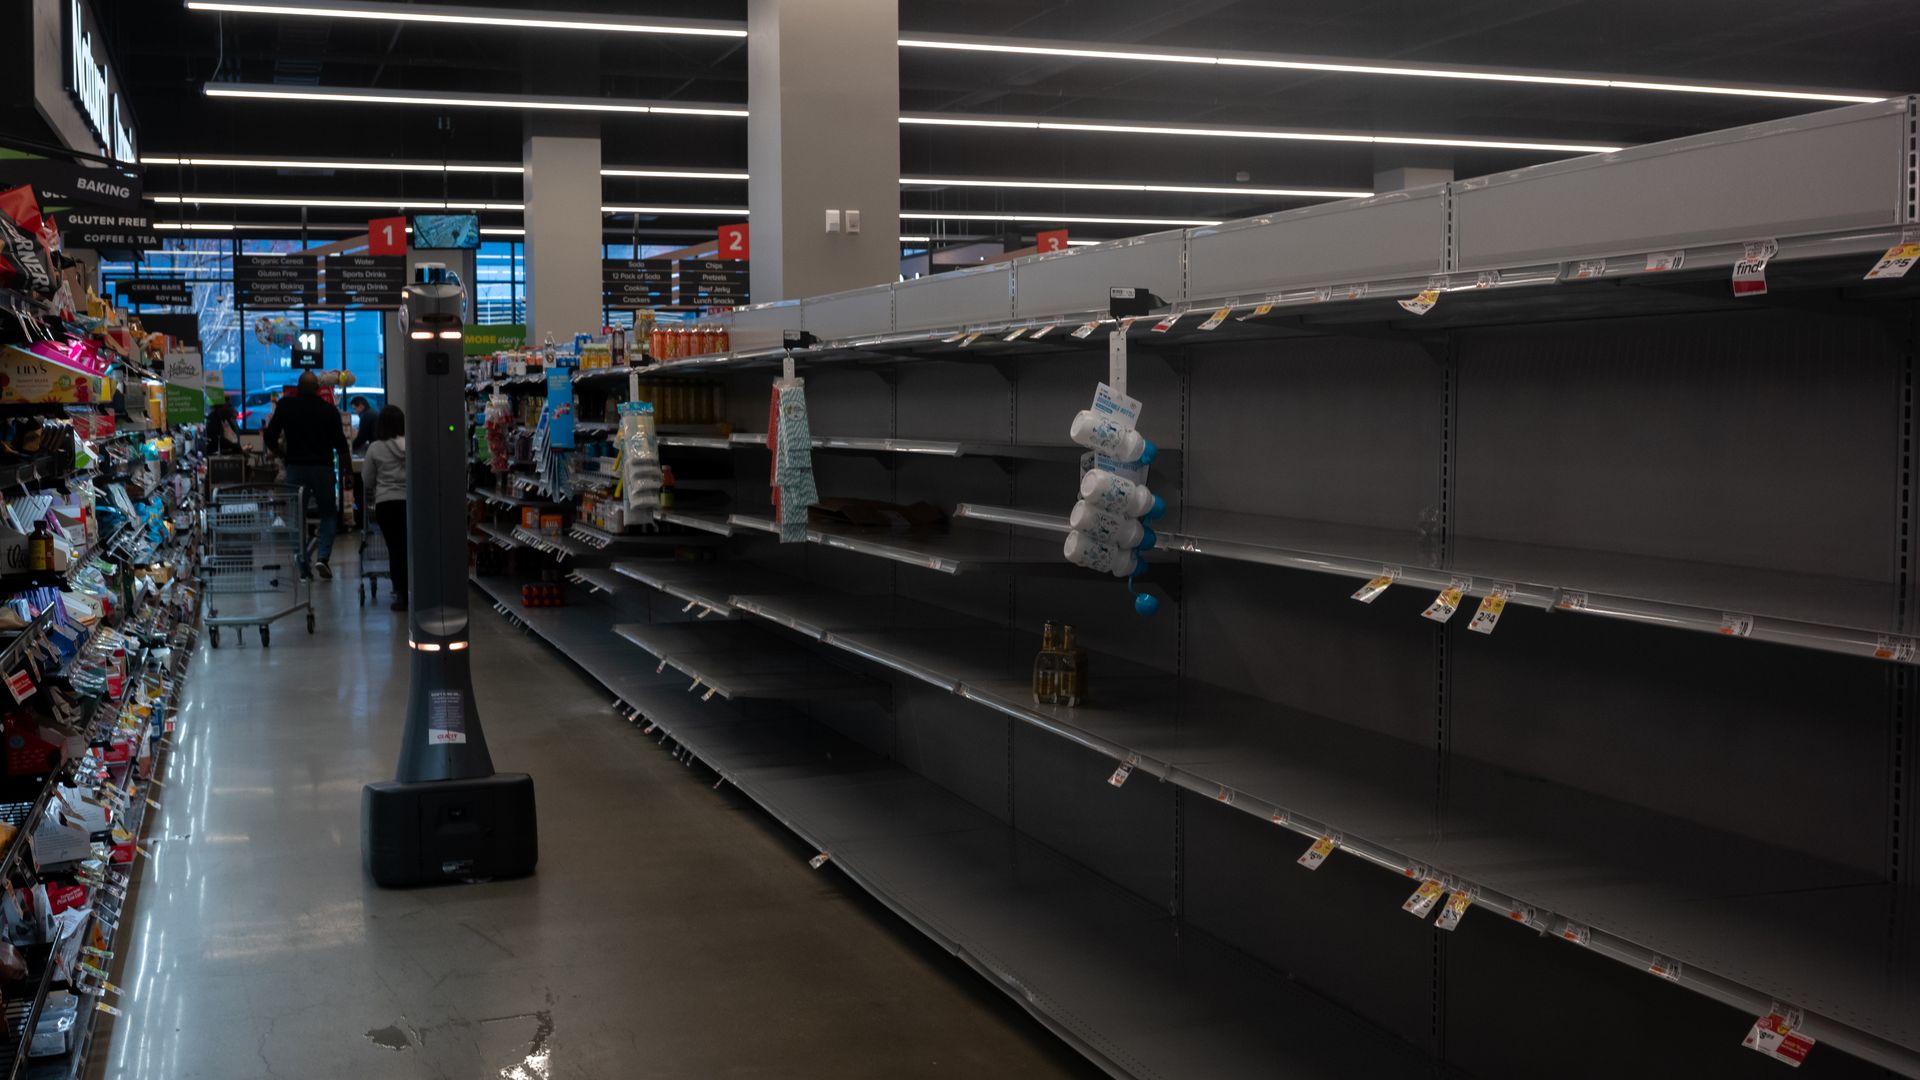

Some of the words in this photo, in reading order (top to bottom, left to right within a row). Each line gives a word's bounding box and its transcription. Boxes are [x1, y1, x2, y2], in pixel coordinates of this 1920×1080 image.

[71, 0, 111, 152] Natural
[77, 177, 131, 199] BAKING
[68, 214, 116, 227] GLUTEN
[117, 215, 148, 228] FREE
[83, 233, 124, 244] COFFEE
[136, 234, 158, 245] TEA
[382, 224, 393, 246] 1
[729, 231, 743, 251] 2
[1047, 237, 1060, 253] 3
[251, 257, 279, 267] Organic
[280, 257, 304, 266] Cereal
[354, 258, 375, 266] Water
[628, 261, 645, 269] Soda
[705, 262, 723, 270] Chips
[1878, 257, 1912, 270] 2/$5
[1736, 260, 1764, 275] find!
[257, 270, 280, 278] Gluten
[282, 270, 299, 278] Free
[342, 270, 364, 279] Sports
[365, 270, 387, 279] Drinks
[620, 272, 636, 280] Pack
[637, 272, 644, 280] of
[644, 272, 661, 280] Soda
[702, 273, 727, 282] Pretzels
[251, 282, 279, 291] Organic
[280, 282, 305, 291] Baking
[341, 283, 364, 292] Energy
[366, 283, 388, 291] Drinks
[623, 284, 649, 292] Cookies
[698, 285, 714, 293] Beef
[714, 285, 731, 294] Jerky
[253, 295, 281, 304] Organic
[282, 295, 303, 304] Chips
[622, 296, 651, 304] Crackers
[693, 297, 712, 305] Lunch
[713, 297, 735, 305] Snacks
[298, 333, 317, 351] 11
[464, 335, 497, 345] MORE
[1432, 604, 1452, 615] 2/$6
[1476, 611, 1496, 624] 2/$4
